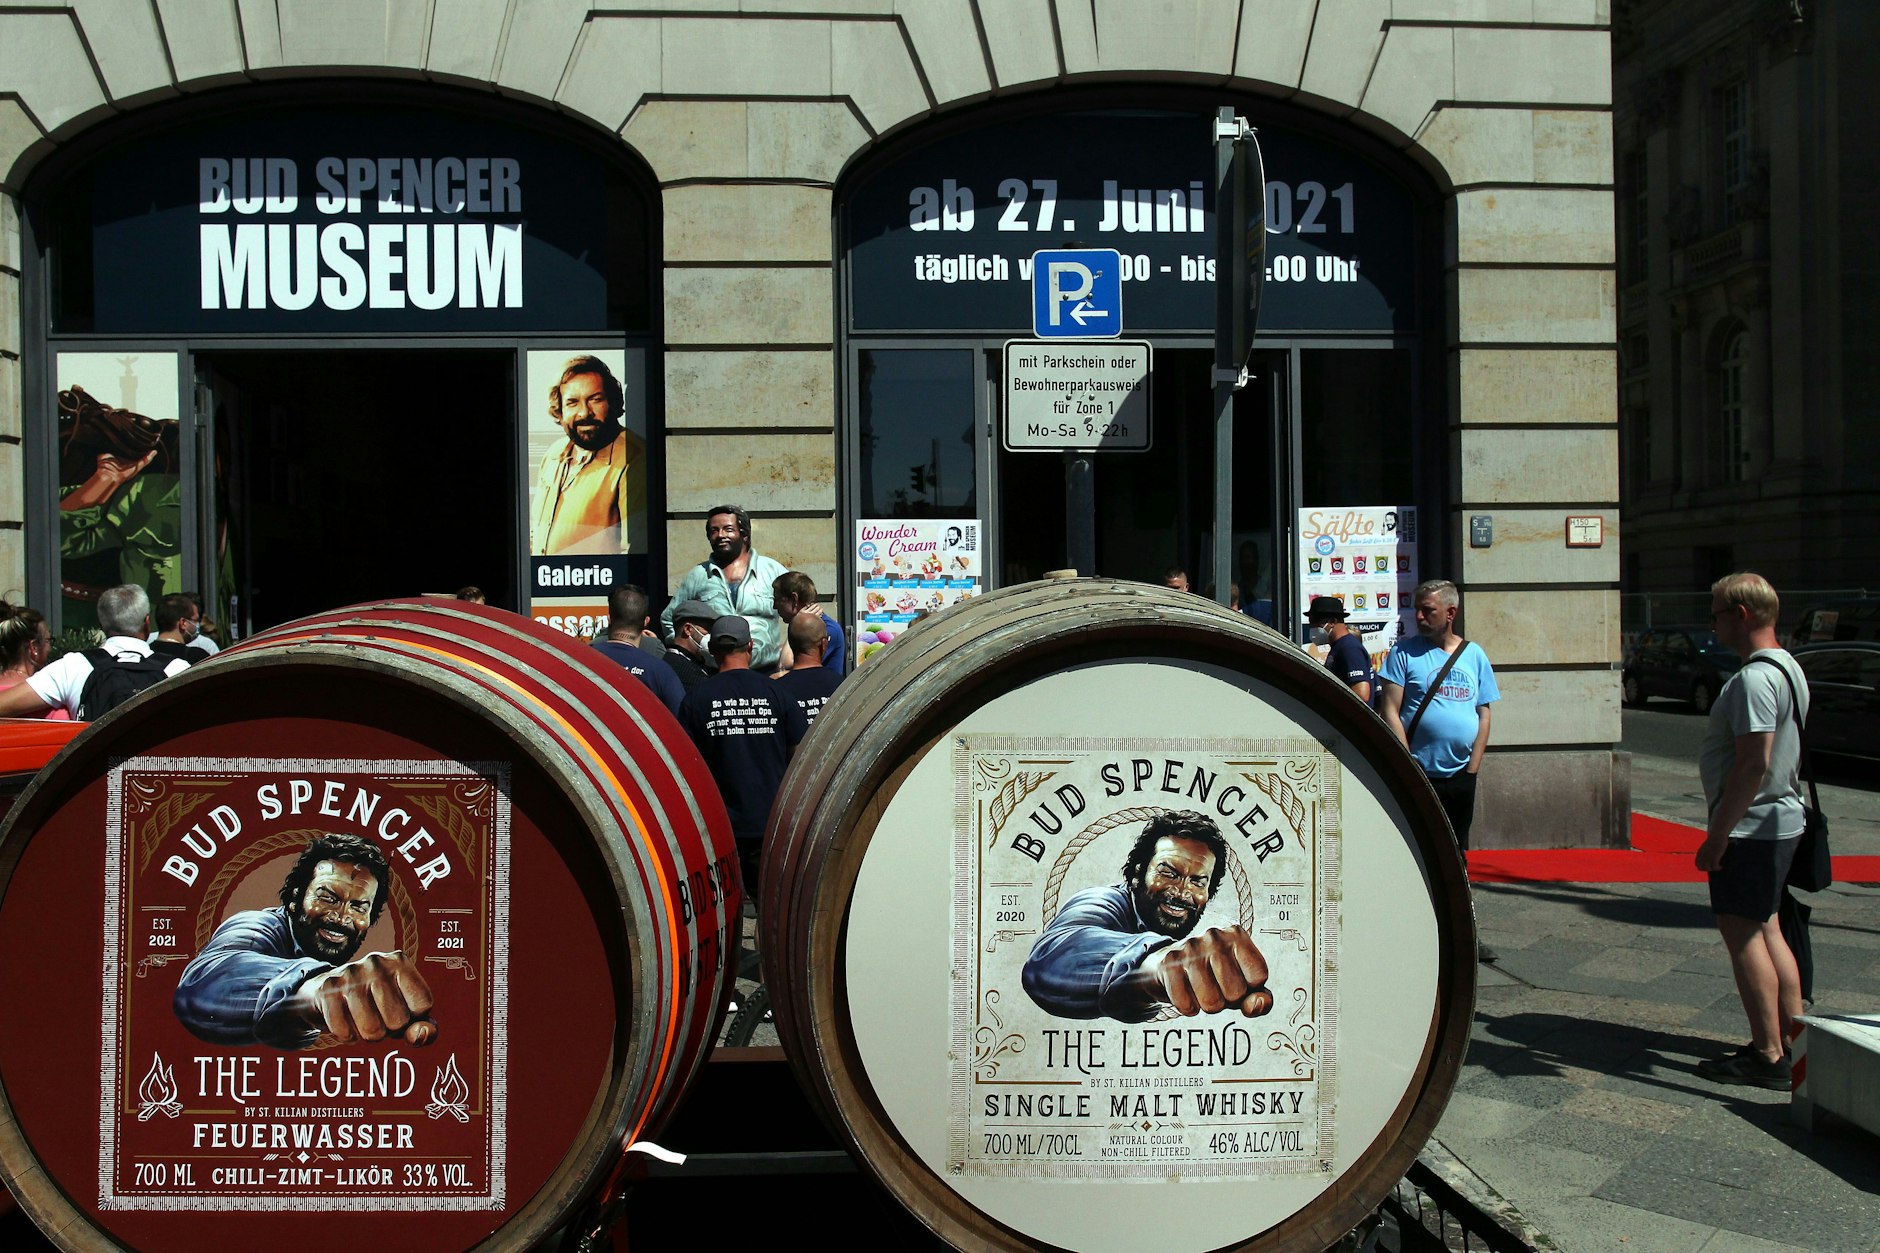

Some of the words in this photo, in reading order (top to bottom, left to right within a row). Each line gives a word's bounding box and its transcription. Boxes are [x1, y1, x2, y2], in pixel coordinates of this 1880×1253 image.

[199, 157, 298, 214] BUD
[315, 156, 522, 215] SPENCER
[908, 178, 975, 233] ab
[997, 178, 1075, 233] 27.
[1099, 179, 1205, 233] Juni
[1263, 180, 1355, 235] 021
[199, 222, 524, 311] MUSEUM
[914, 254, 1009, 284] täglich
[1180, 255, 1216, 283] bis
[1315, 255, 1360, 283] Uhr
[1048, 261, 1095, 326] P
[1018, 355, 1038, 369] mit
[1043, 355, 1106, 369] Parkschein
[1110, 355, 1137, 369] oder
[1013, 377, 1142, 394] Bewohnerparkausweis
[1053, 401, 1071, 415] für
[1076, 401, 1103, 415] Zone
[1108, 401, 1114, 415] 1
[1027, 423, 1077, 437] Mo-Sa
[861, 523, 918, 541] Wonder
[1301, 511, 1375, 544] Säfte
[888, 538, 937, 558] Cream
[537, 564, 613, 587] Galerie
[758, 706, 773, 717] Opa
[1010, 783, 1087, 864] BUD
[1100, 758, 1286, 865] SPENCER
[160, 803, 244, 889] BUD
[256, 779, 454, 890] SPENCER
[677, 870, 708, 926] BUD
[1001, 894, 1021, 906] EST.
[1270, 894, 1299, 905] BATCH
[152, 918, 174, 930] EST.
[996, 911, 1025, 922] 2020
[1278, 910, 1290, 921] 01
[440, 920, 462, 933] EST.
[148, 934, 177, 947] 2021
[437, 937, 465, 949] 2021
[1042, 1027, 1107, 1075] THE
[1120, 1020, 1253, 1069] LEGEND
[193, 1056, 261, 1105] THE
[275, 1049, 417, 1099] LEGEND
[1090, 1078, 1101, 1088] BY
[1104, 1078, 1117, 1088] ST.
[1119, 1078, 1151, 1088] KILIAN
[1153, 1076, 1204, 1088] DISTILLERS
[244, 1107, 256, 1118] BY
[258, 1107, 273, 1118] ST.
[274, 1107, 308, 1118] KILIAN
[311, 1107, 365, 1118] DISTILLERS
[984, 1093, 1092, 1118] SINGLE
[1108, 1093, 1184, 1118] MALT
[1195, 1090, 1305, 1117] WHISKY
[192, 1122, 415, 1149] FEUERWASSER
[984, 1133, 1013, 1156] 700
[1016, 1133, 1083, 1156] ML/70CL
[1208, 1132, 1240, 1154] 46%
[1109, 1134, 1148, 1146] NATURAL
[1149, 1134, 1184, 1146] COLOUR
[1101, 1147, 1149, 1158] NON-CHILL
[1151, 1145, 1191, 1157] FILTERED
[134, 1163, 167, 1187] 700
[173, 1164, 196, 1187] ML
[210, 1164, 395, 1187] CHILI-ZIMT-LIKÖR
[442, 1163, 474, 1188] VOL.
